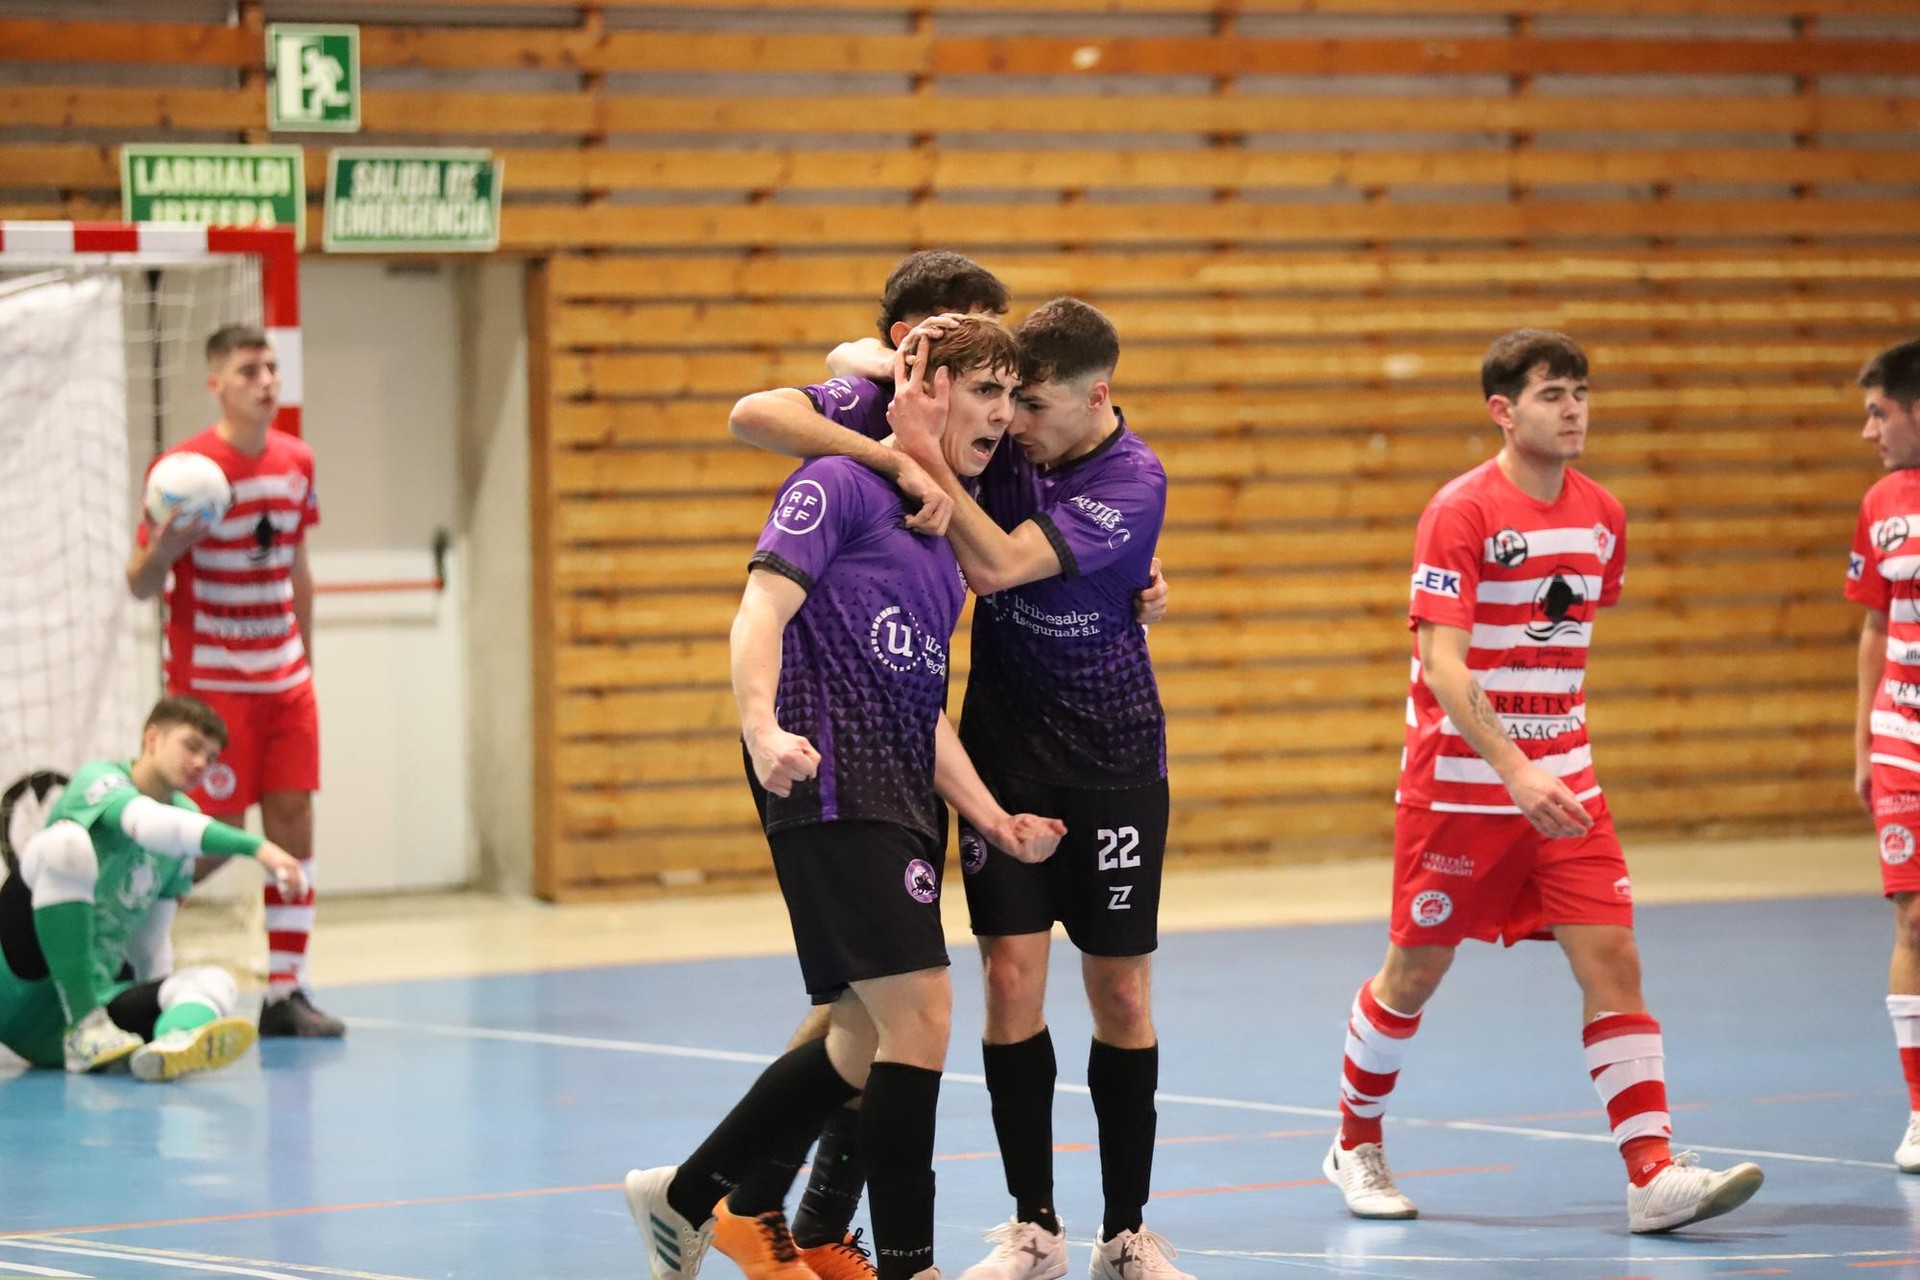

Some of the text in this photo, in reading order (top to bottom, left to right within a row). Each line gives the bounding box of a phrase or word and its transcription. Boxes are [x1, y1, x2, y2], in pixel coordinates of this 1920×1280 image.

[134, 157, 291, 196] LARRIALDI
[351, 160, 440, 198] SALIDA
[333, 199, 492, 236] EMERGENCIA
[1014, 594, 1099, 626] Uribesalgo
[1097, 825, 1141, 870] 22
